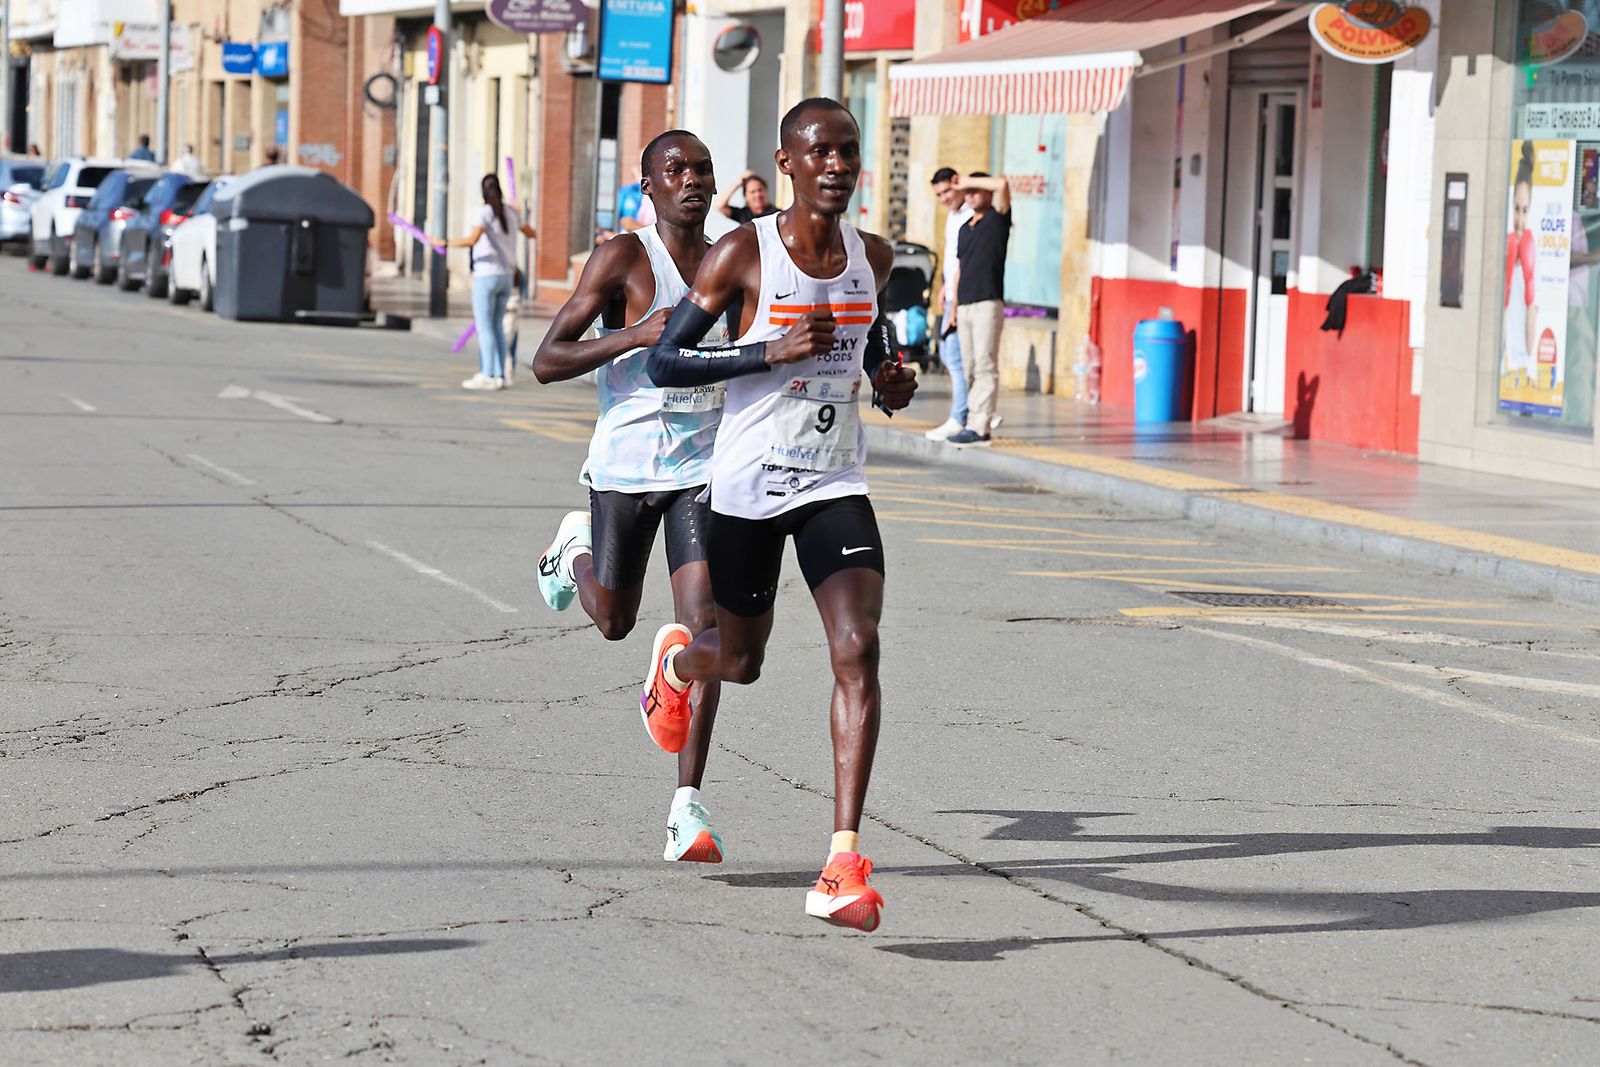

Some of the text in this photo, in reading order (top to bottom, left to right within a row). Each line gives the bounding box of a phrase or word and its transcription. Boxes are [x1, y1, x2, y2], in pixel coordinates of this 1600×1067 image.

[1328, 17, 1417, 46] POLVILLO
[1541, 218, 1565, 232] GOLPE
[817, 353, 852, 362] FOODS
[666, 393, 703, 404] Huelva
[815, 404, 836, 434] 9
[772, 445, 816, 461] Huelva
